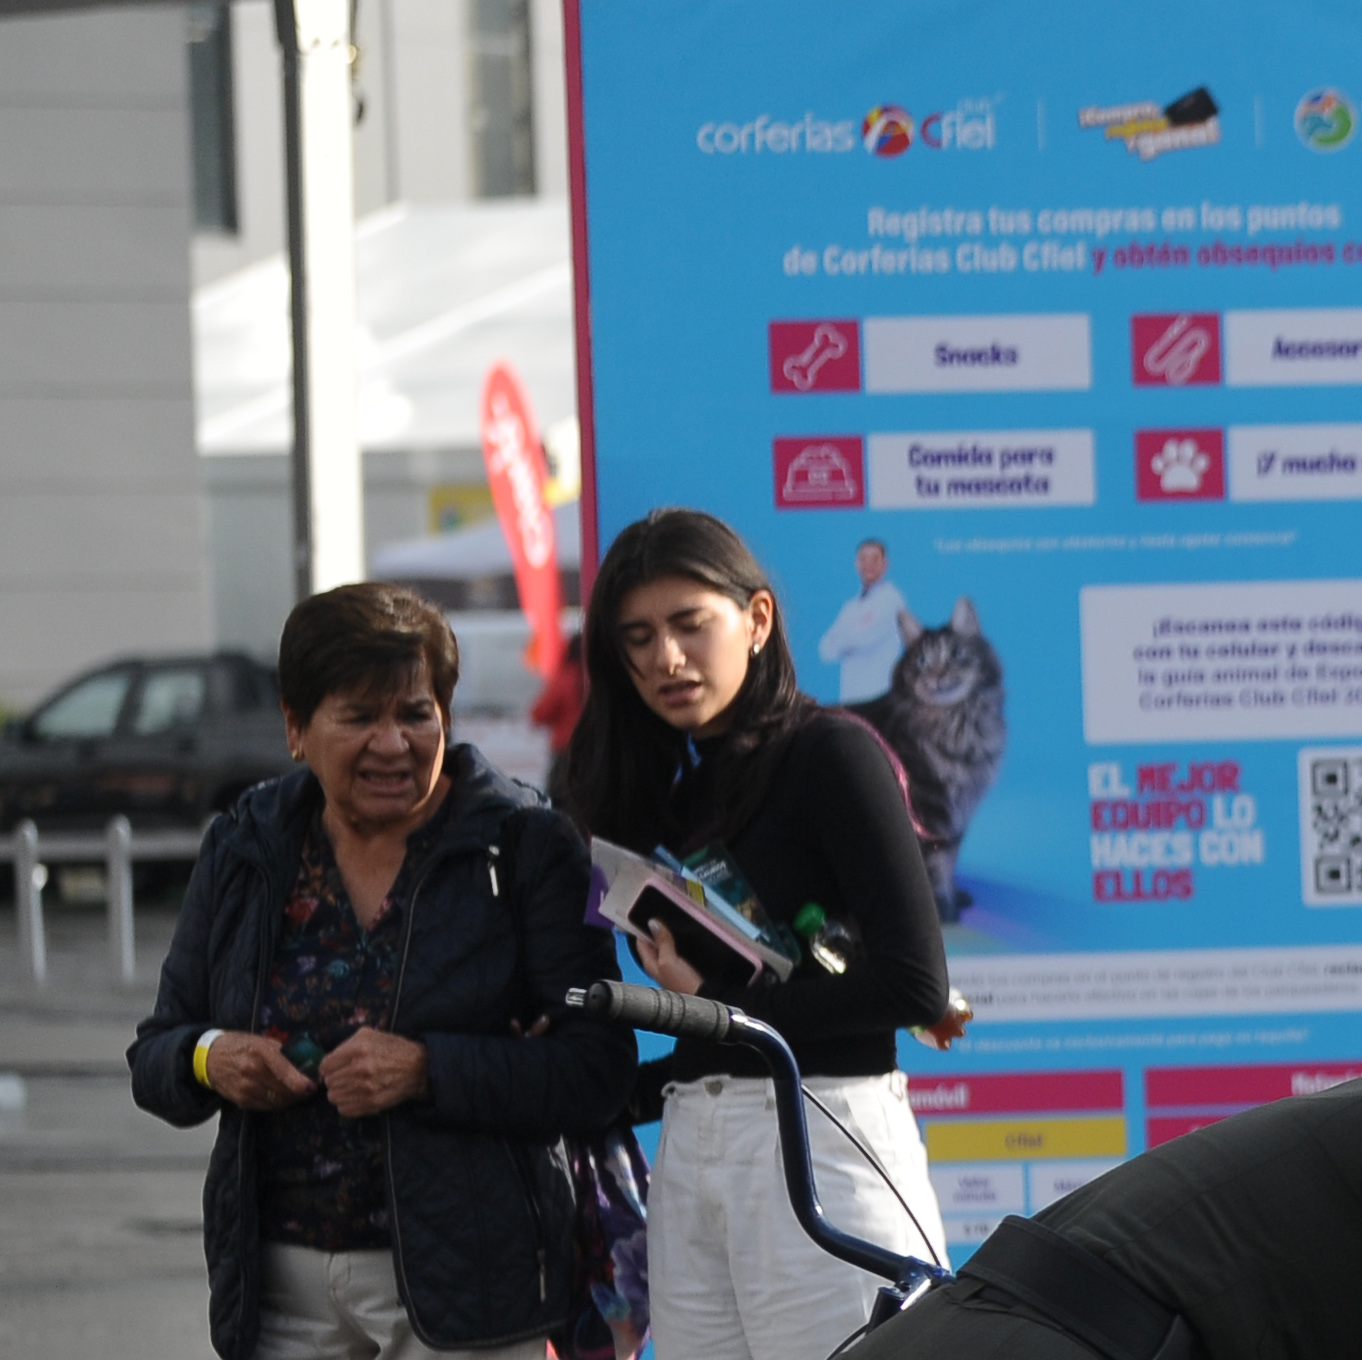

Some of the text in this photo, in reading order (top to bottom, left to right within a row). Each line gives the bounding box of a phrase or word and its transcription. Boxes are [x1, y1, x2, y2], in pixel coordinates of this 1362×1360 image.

[697, 112, 856, 152] corferias
[868, 202, 1341, 243] Registra tus compras en los puntos
[783, 244, 818, 276] de
[824, 244, 950, 276] Corferias
[957, 241, 1018, 273] Club
[1023, 240, 1087, 272] Cfiel
[1092, 247, 1107, 275] y
[1113, 239, 1190, 269] obtén
[1197, 238, 1335, 272] obsequios
[934, 341, 1019, 368] Snacks
[907, 442, 1055, 471] Comida para
[1281, 449, 1357, 475] mucho
[915, 472, 1051, 498] tu mascota
[1256, 615, 1303, 634] este
[1132, 643, 1172, 662] con
[1178, 642, 1200, 660] tu
[1204, 640, 1279, 660] celular
[1286, 642, 1297, 660] y
[1137, 667, 1156, 686] la
[1161, 666, 1205, 687] guía
[1211, 664, 1279, 685] animal
[1284, 664, 1309, 682] de
[1138, 689, 1233, 712] Corferias
[1238, 687, 1285, 709] Club
[1088, 758, 1241, 800] EL MEJOR
[1090, 793, 1256, 834] EQUIPO LO
[1090, 827, 1266, 868] HACES CON
[1092, 868, 1195, 904] ELLOS
[908, 1081, 969, 1111] omóvil
